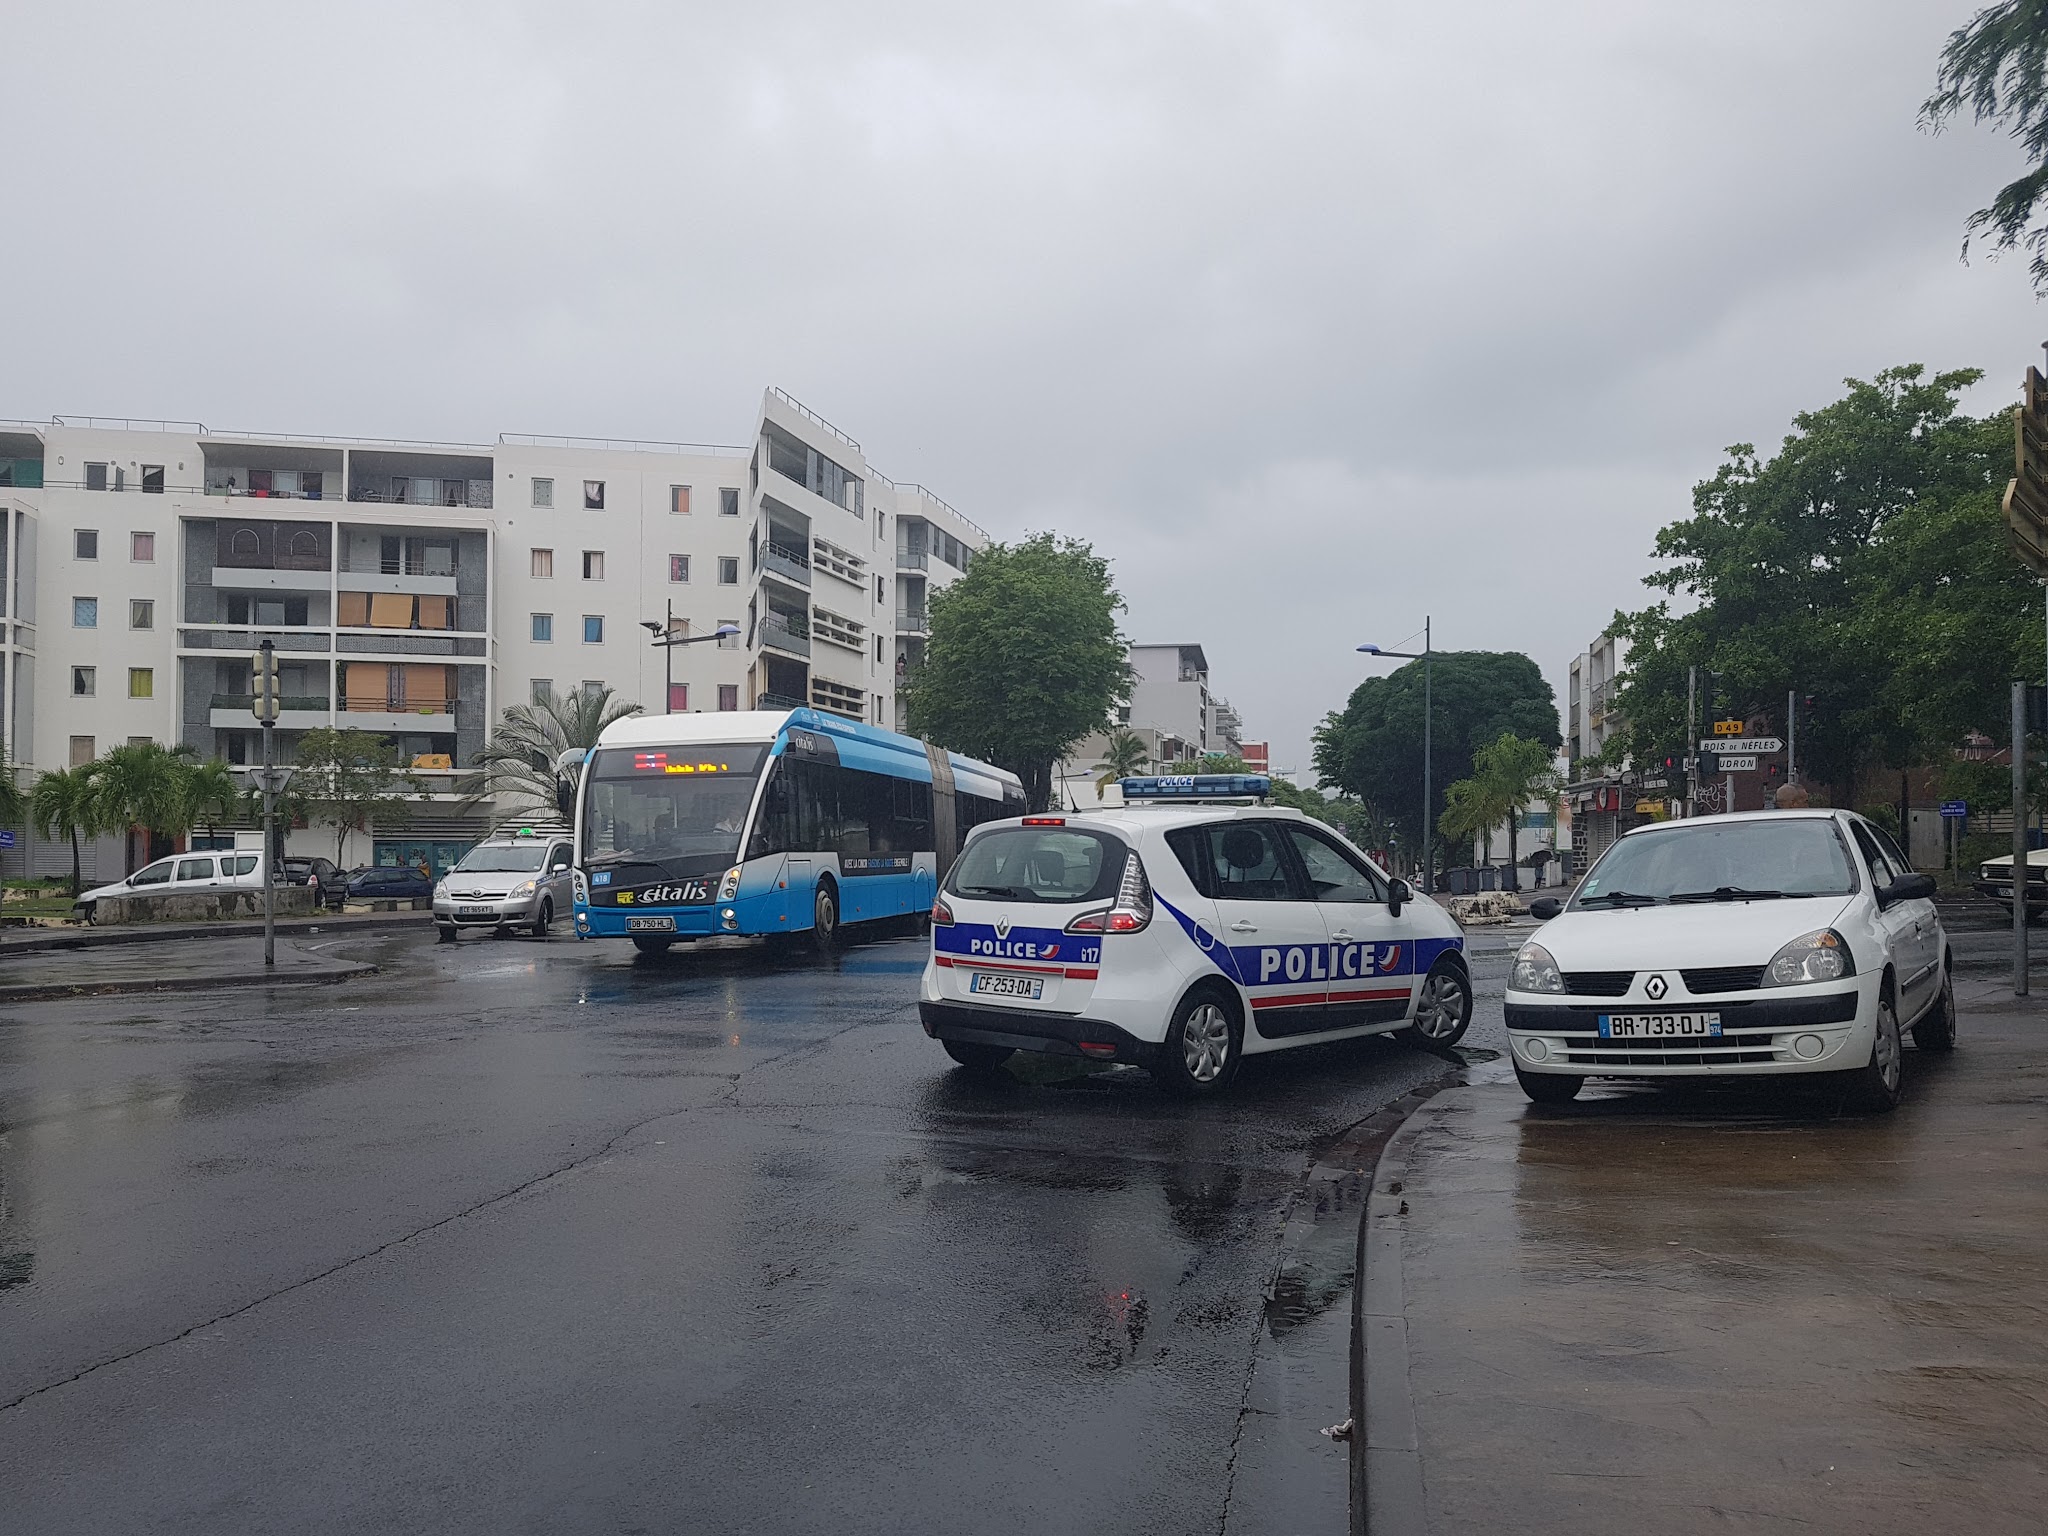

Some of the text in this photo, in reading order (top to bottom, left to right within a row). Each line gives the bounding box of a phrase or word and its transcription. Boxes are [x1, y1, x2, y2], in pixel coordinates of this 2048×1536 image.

[1703, 743, 1726, 751] BOIS
[1719, 759, 1754, 768] UDRON
[1159, 776, 1193, 786] POLICE
[594, 874, 608, 883] 418
[637, 882, 707, 903] citalis
[971, 939, 1037, 958] POLICE
[1260, 944, 1376, 982] POLICE
[978, 976, 1032, 995] CF-253-DA
[1612, 1015, 1705, 1036] BR-733-DJ
